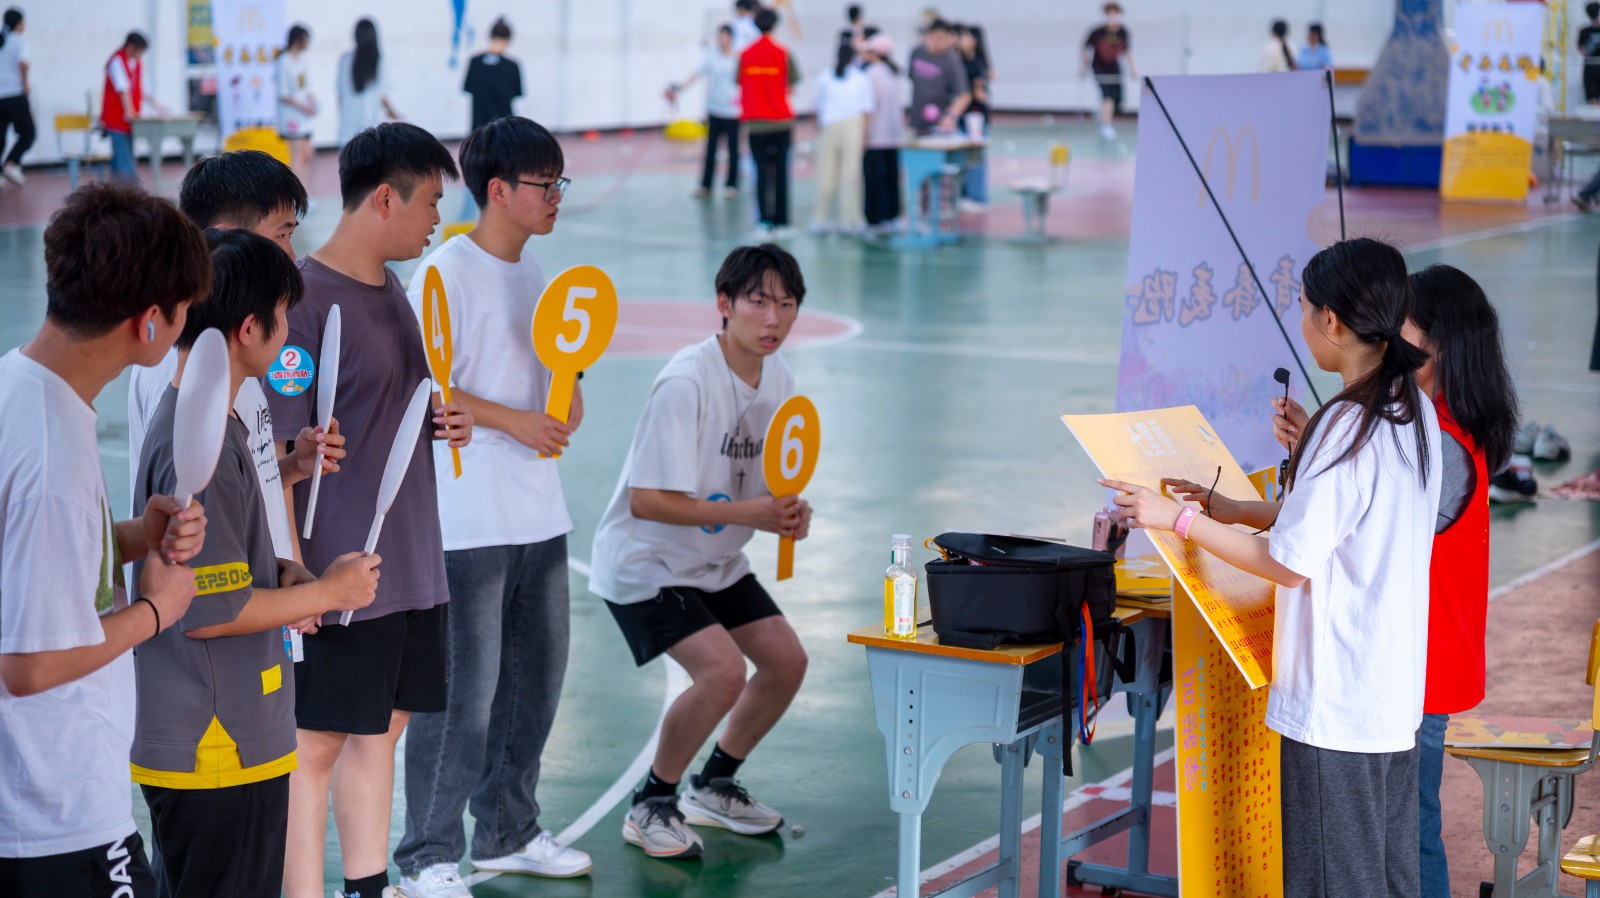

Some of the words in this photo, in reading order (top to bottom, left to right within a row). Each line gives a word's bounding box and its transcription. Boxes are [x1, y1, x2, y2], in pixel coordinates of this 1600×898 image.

[431, 287, 445, 362] 4
[555, 286, 597, 353] 5
[285, 351, 297, 367] 2
[780, 414, 805, 480] 6
[1181, 666, 1200, 792] 学猫叫
